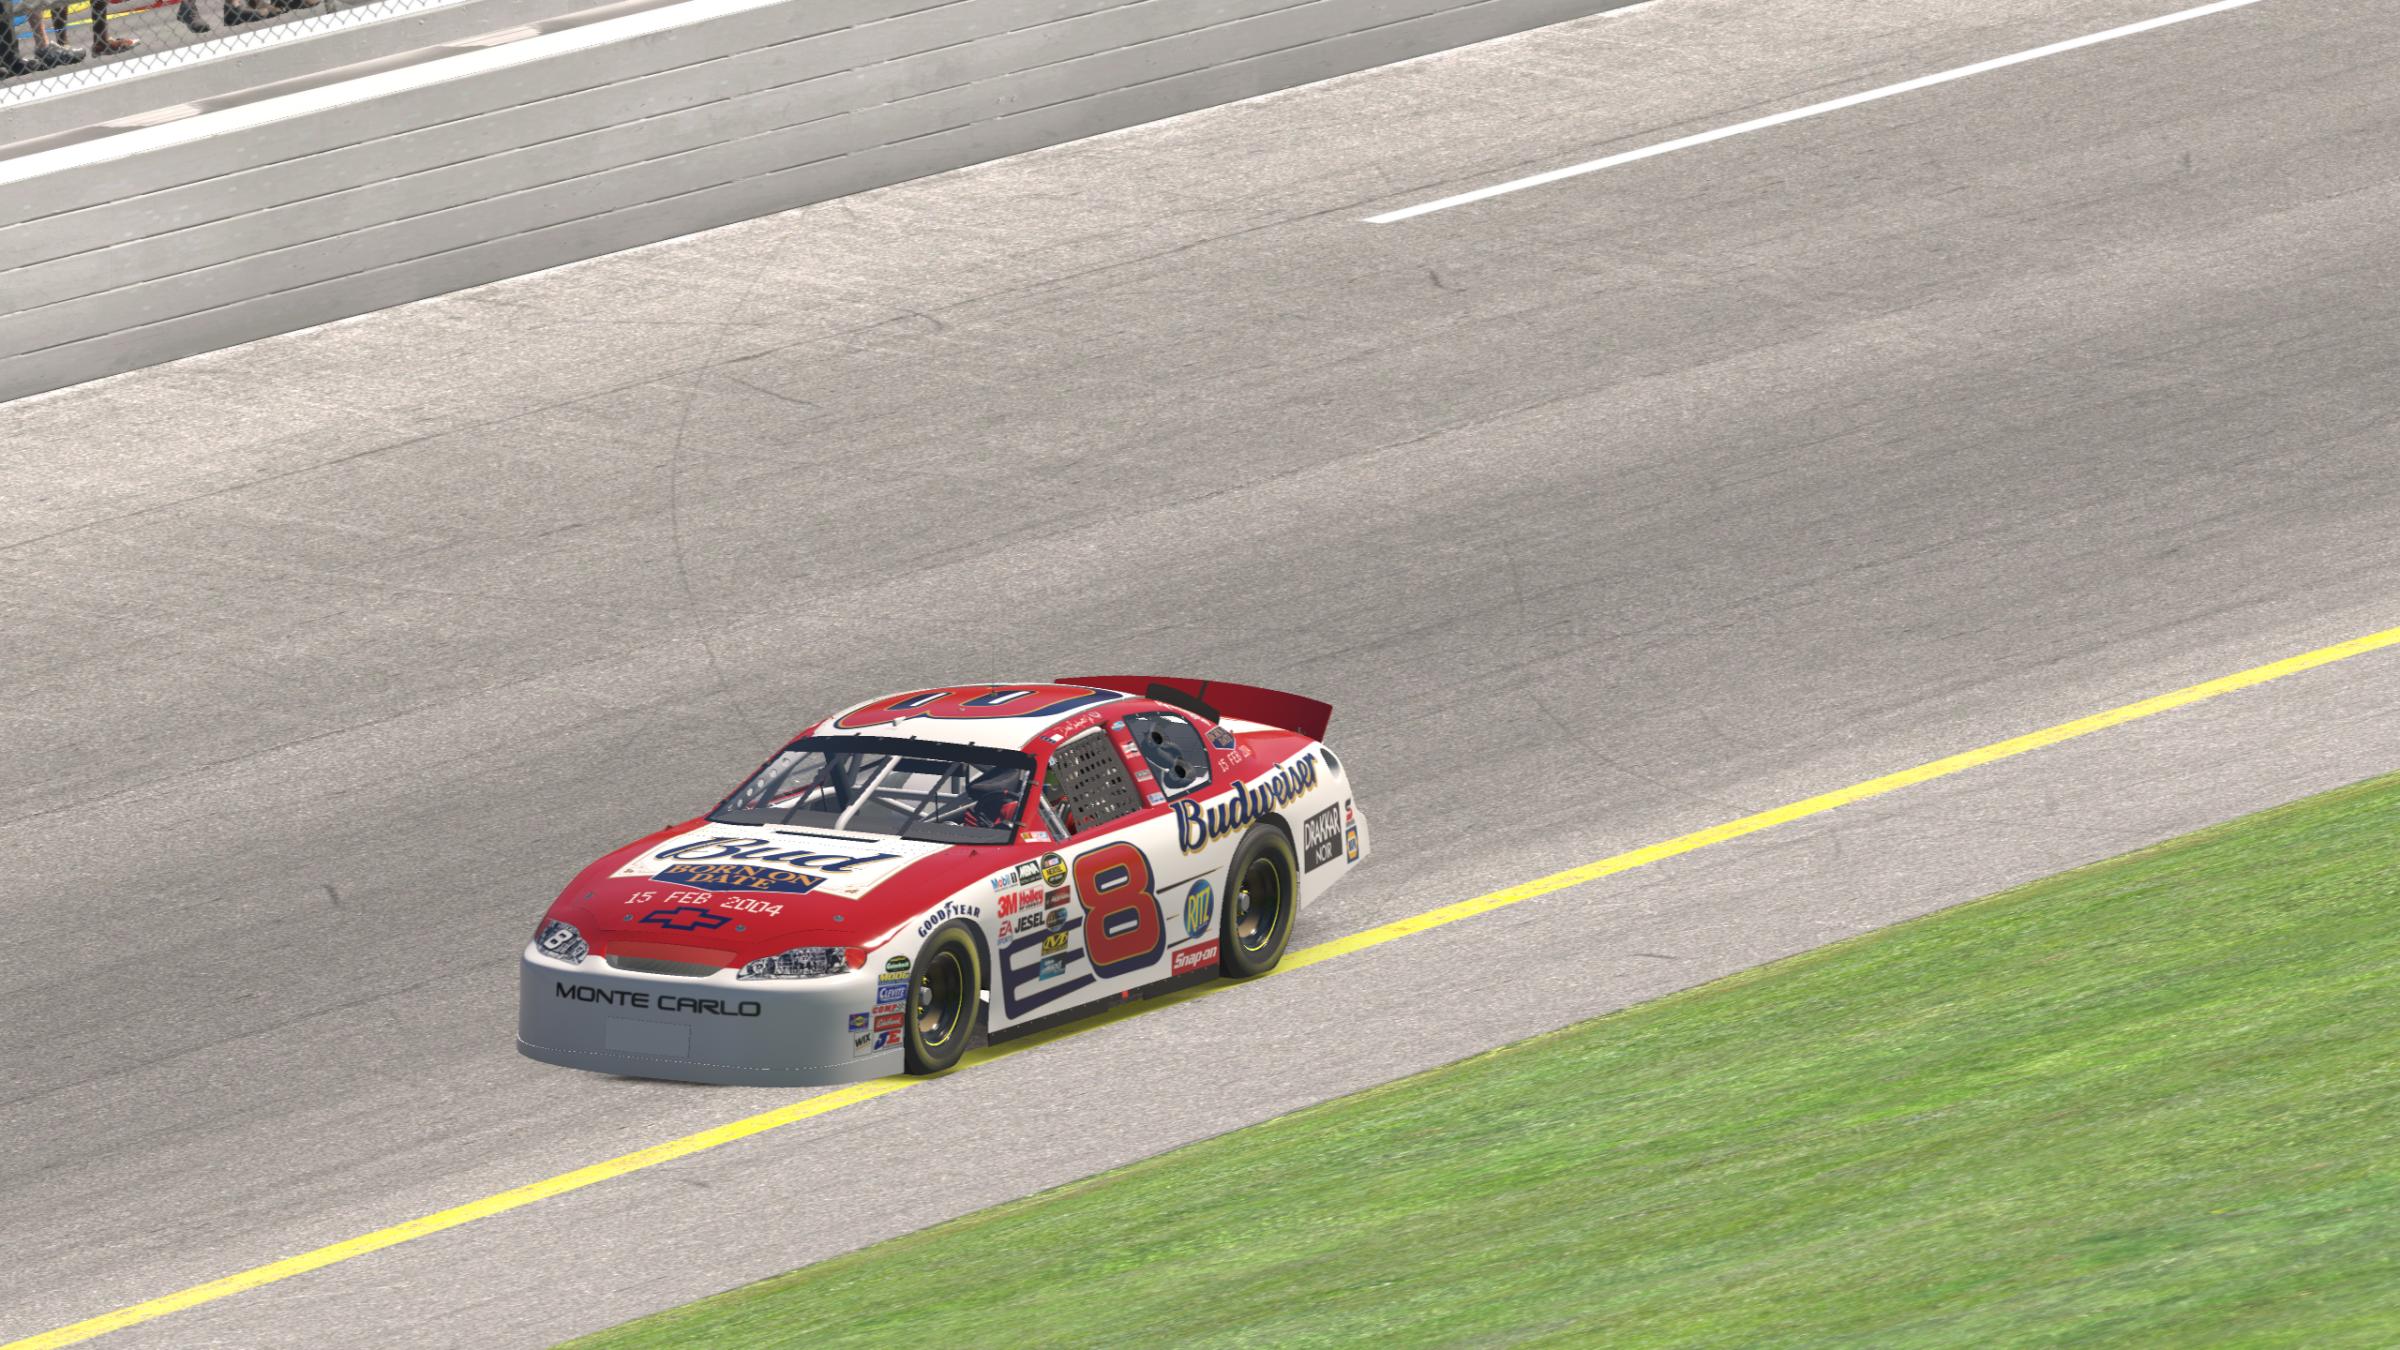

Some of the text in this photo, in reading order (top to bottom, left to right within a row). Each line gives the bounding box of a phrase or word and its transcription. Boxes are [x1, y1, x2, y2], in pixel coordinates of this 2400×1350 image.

[1169, 752, 1320, 857] Budweiser
[1305, 807, 1341, 851] DRAKKAR
[654, 836, 902, 874] Bud
[1316, 842, 1333, 865] NOIR
[667, 863, 819, 888] BORN ON
[687, 873, 777, 890] DATE
[624, 891, 784, 917] 15 FEB 2004
[998, 892, 1018, 918] 3M
[1072, 841, 1166, 979] 8
[1187, 886, 1211, 933] RITZ
[918, 900, 981, 938] GOODYEAR
[1014, 911, 1045, 933] JESEL
[543, 929, 573, 950] 8
[1174, 946, 1217, 968] Snap-on
[556, 982, 762, 1017] MONTE CARLO
